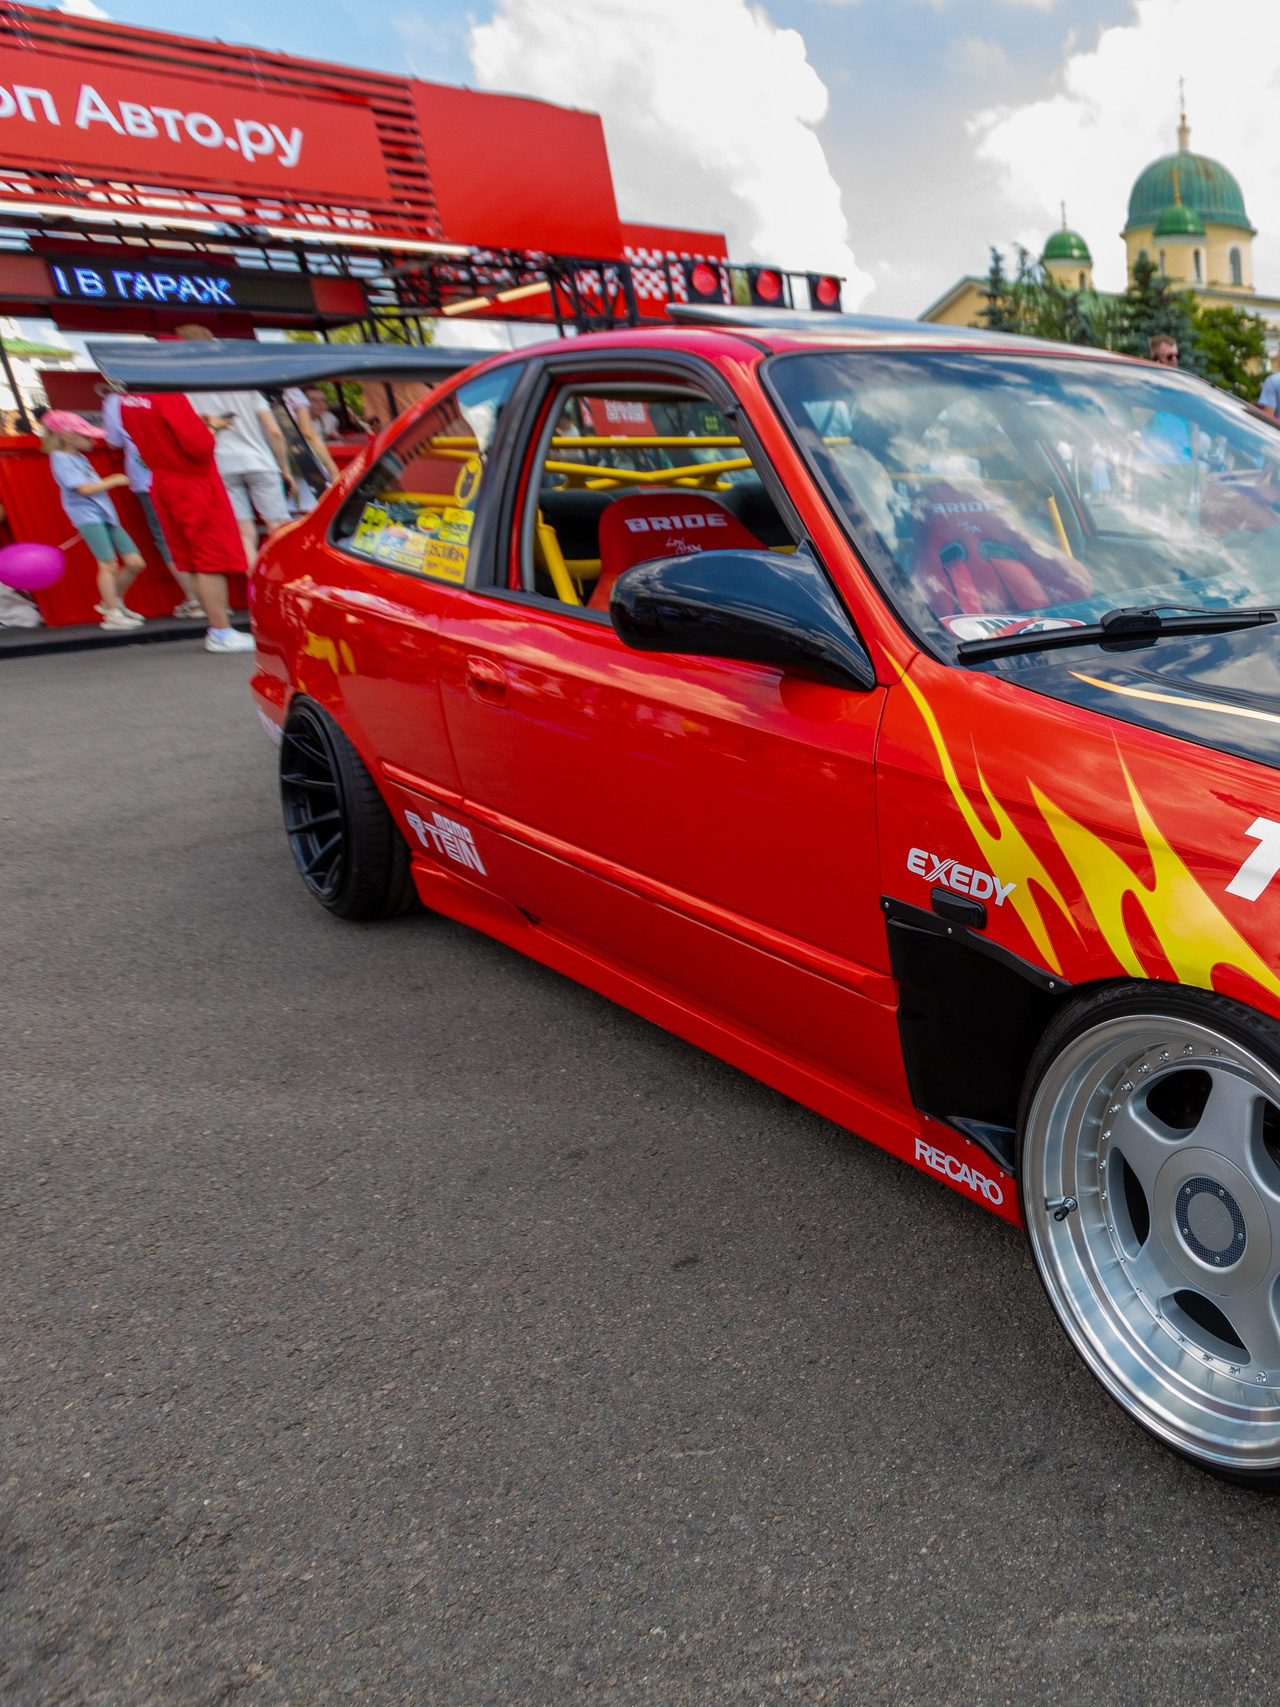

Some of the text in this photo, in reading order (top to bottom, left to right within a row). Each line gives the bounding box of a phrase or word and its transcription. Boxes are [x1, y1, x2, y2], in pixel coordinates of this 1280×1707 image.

[75, 83, 303, 168] Авто.ру
[111, 269, 236, 306] ГАРАЖ
[624, 513, 728, 533] BRIDE
[421, 820, 488, 877] TEIN
[906, 847, 1018, 907] EXEDY
[914, 1137, 1004, 1205] RECARO
